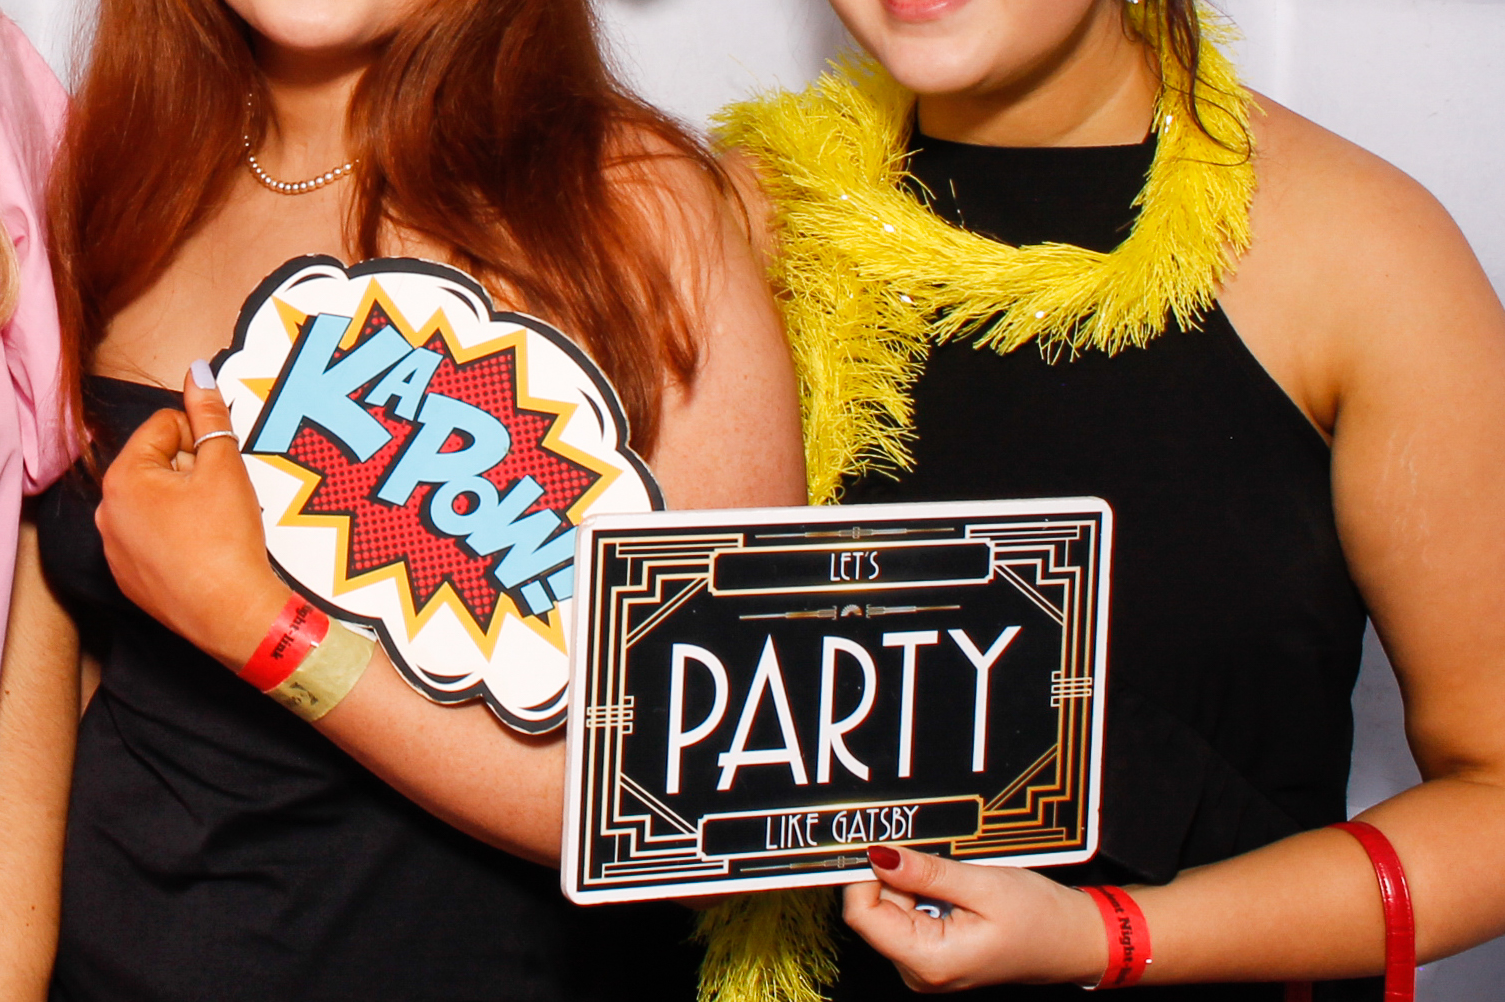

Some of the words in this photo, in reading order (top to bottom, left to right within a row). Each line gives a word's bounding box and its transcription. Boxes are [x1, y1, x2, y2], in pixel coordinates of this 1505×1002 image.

[831, 551, 880, 582] LET'S
[666, 626, 1022, 795] PARTY
[765, 813, 819, 850] LIKE
[832, 805, 920, 844] GATSBY
